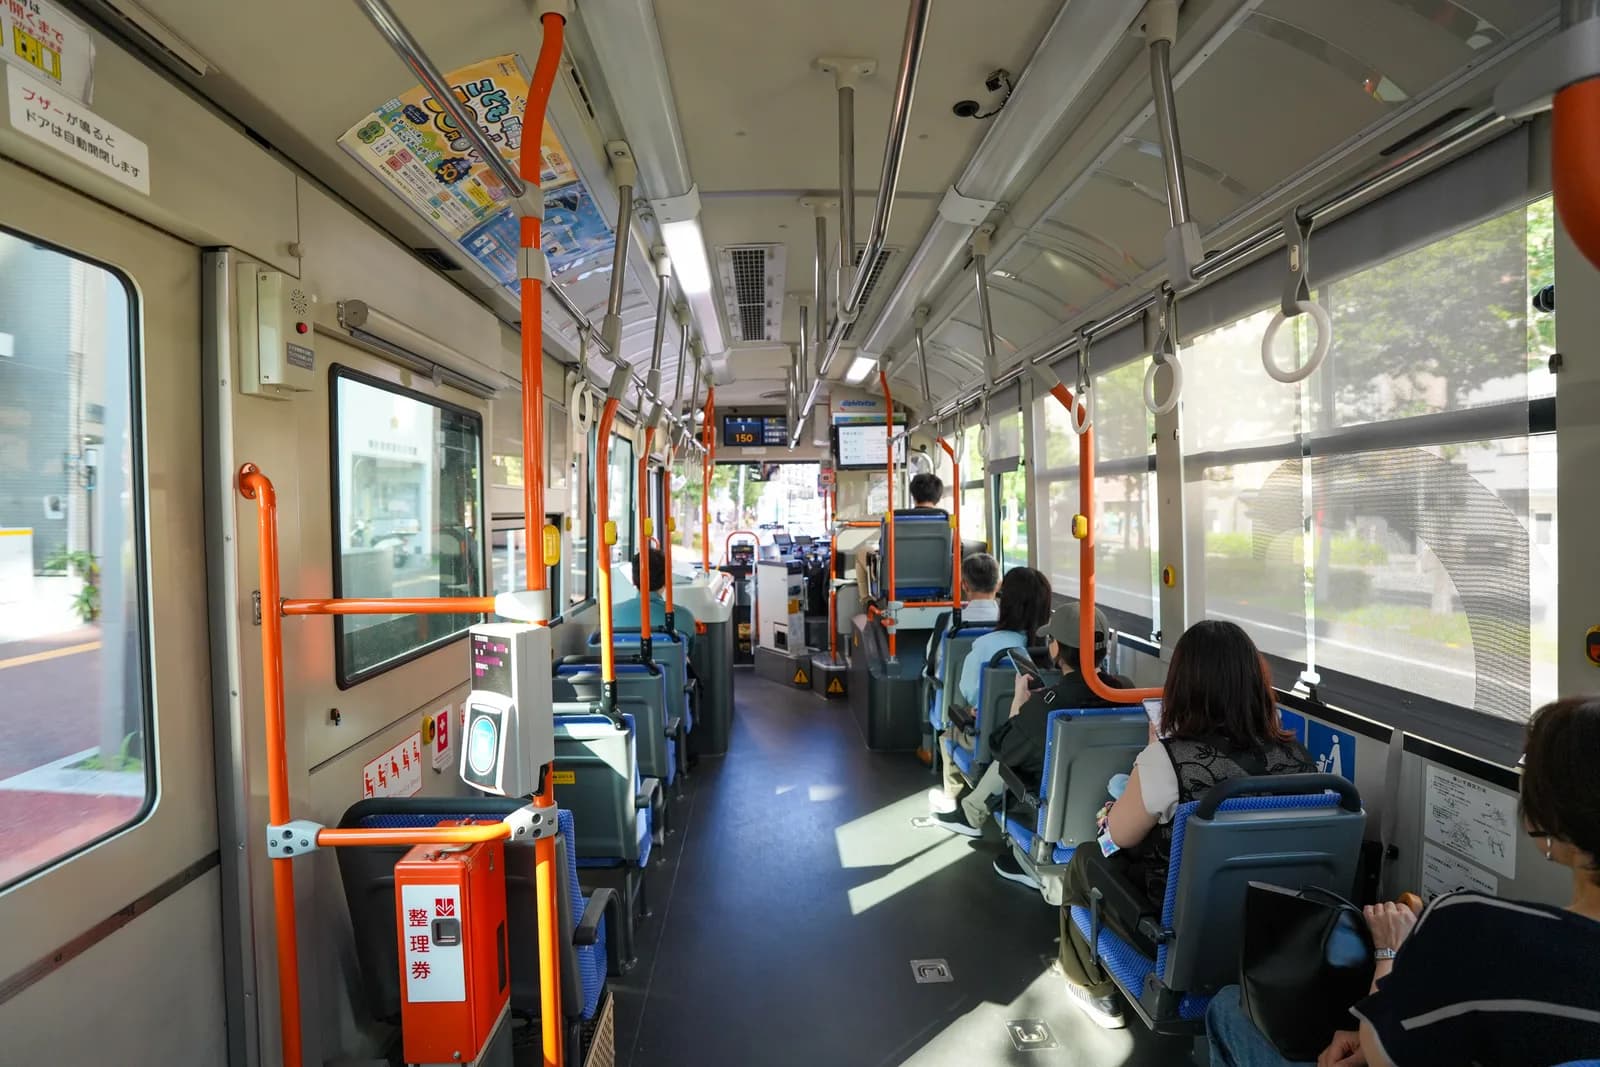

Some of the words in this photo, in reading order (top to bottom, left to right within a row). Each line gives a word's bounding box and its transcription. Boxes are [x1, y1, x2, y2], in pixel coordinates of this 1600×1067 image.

[465, 77, 512, 124] こども
[26, 109, 140, 177] ドアは自動開閉します
[735, 433, 753, 443] 150
[408, 908, 431, 980] 整理券
